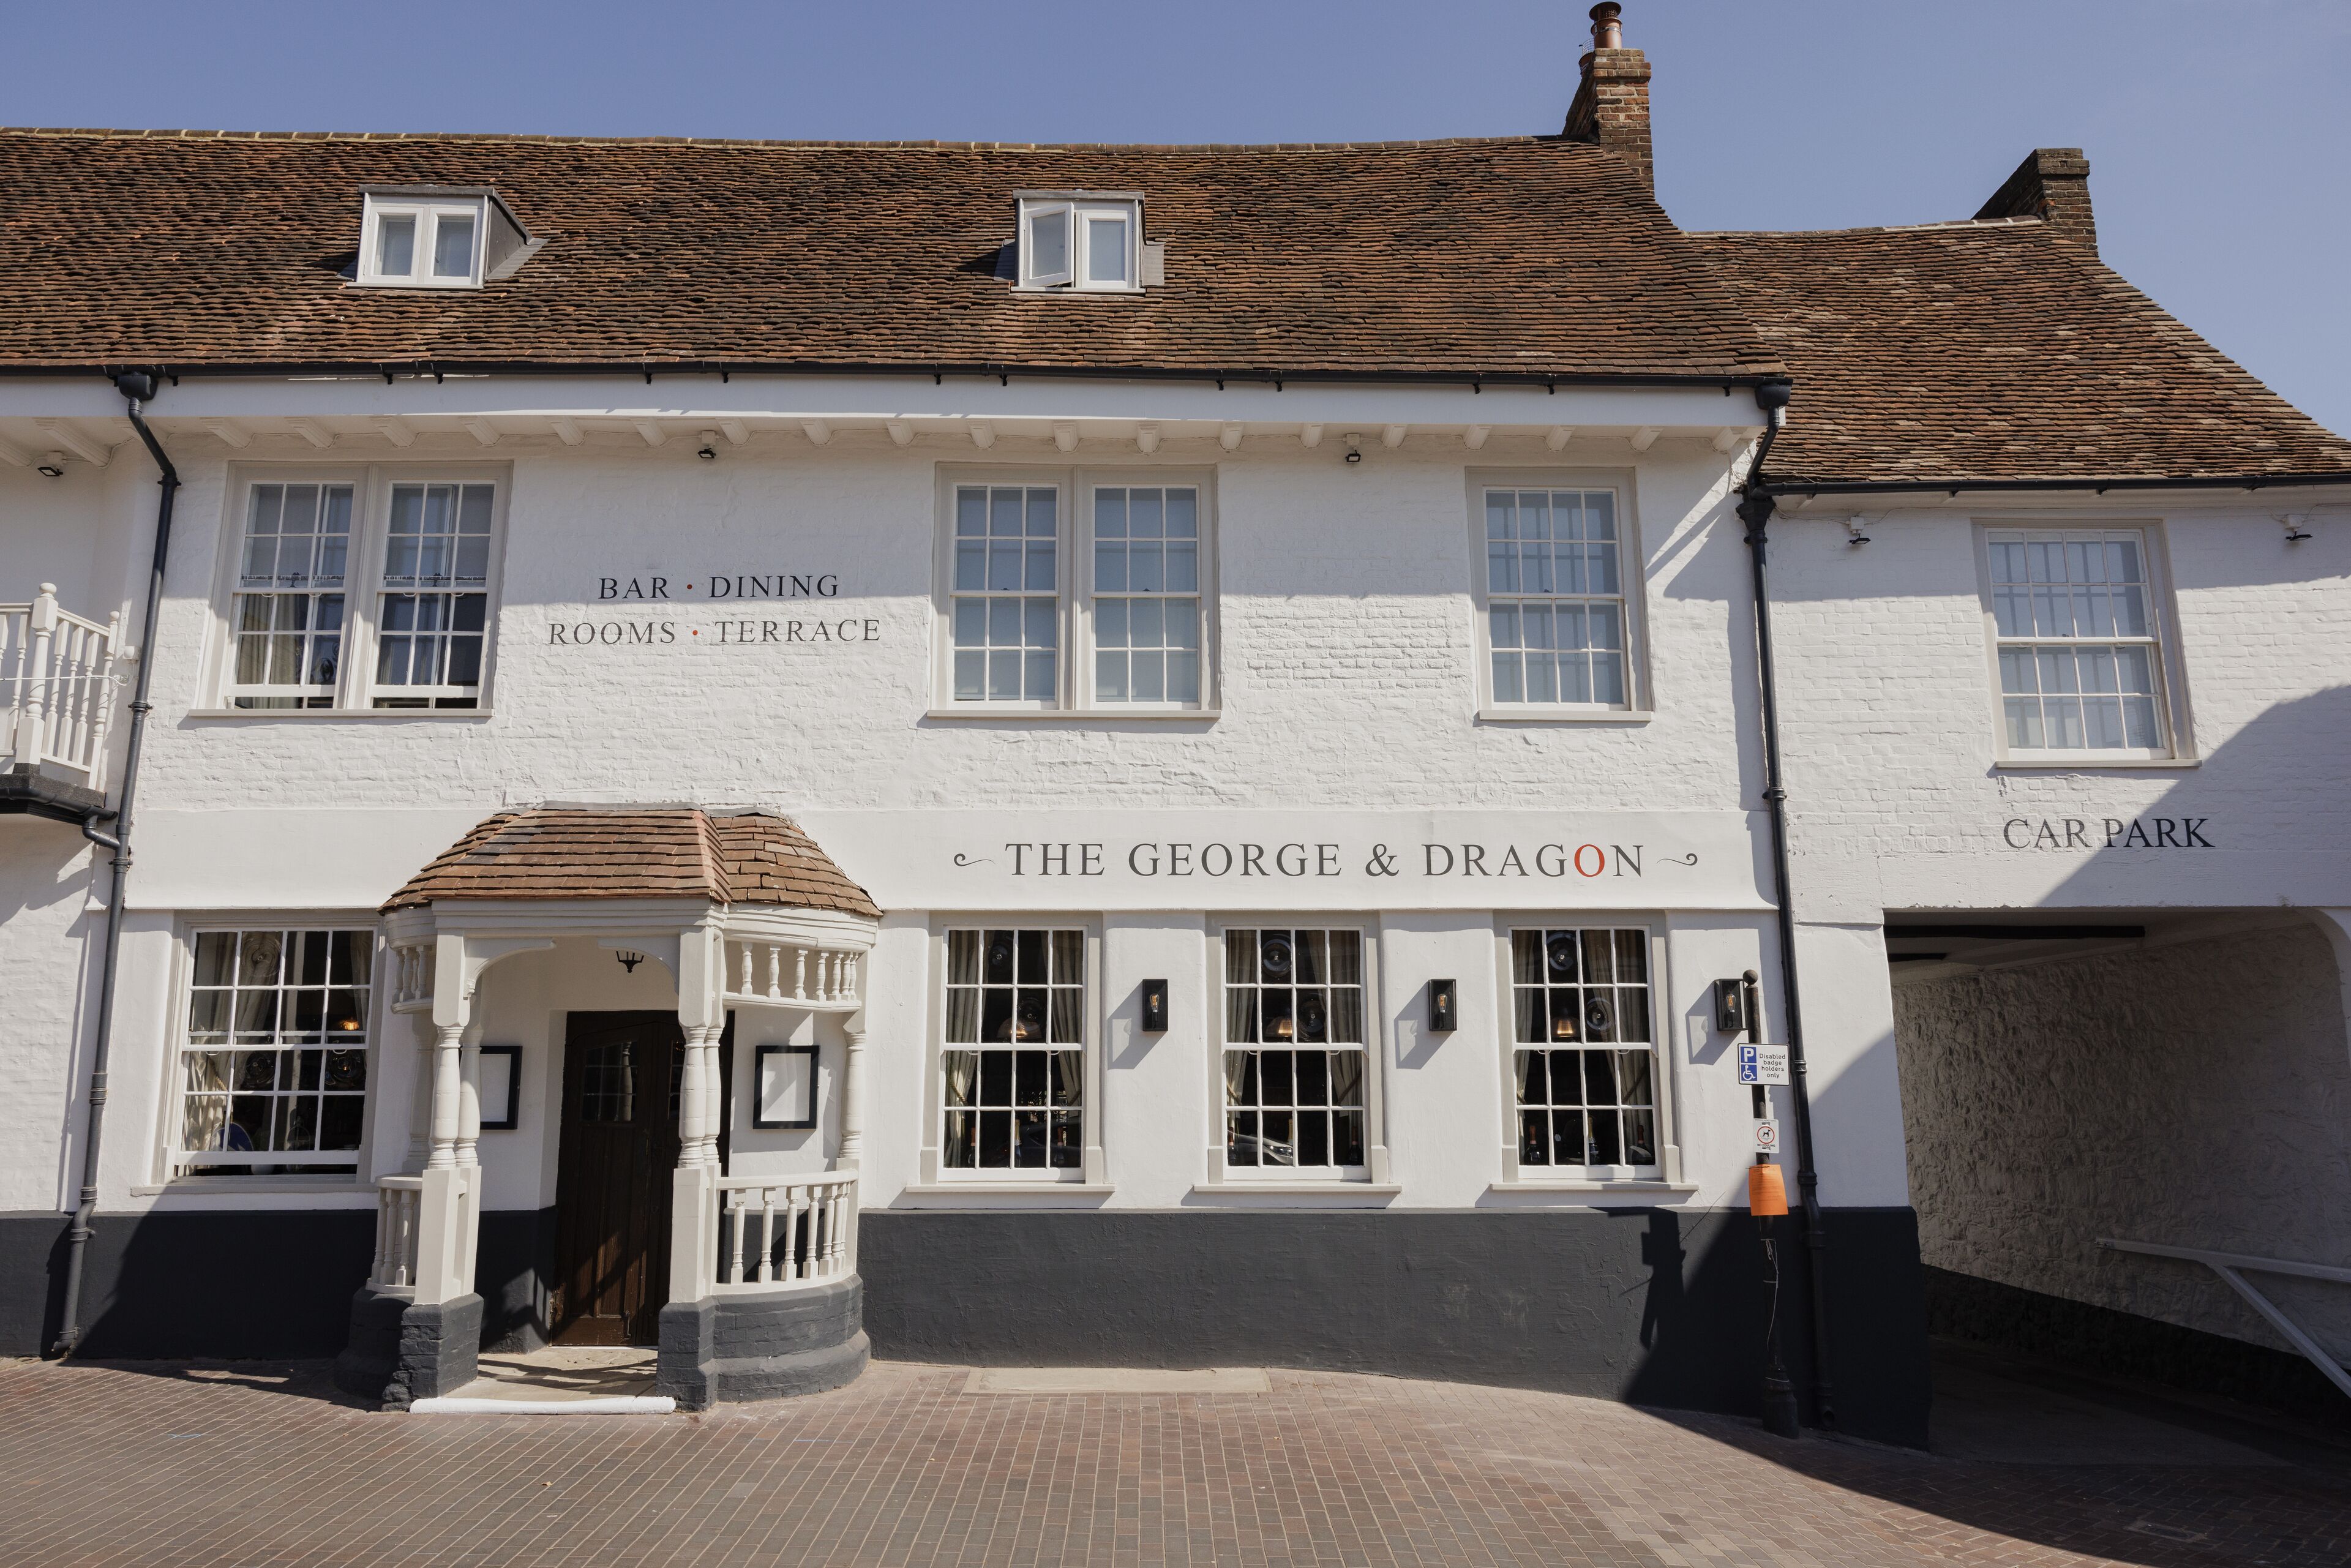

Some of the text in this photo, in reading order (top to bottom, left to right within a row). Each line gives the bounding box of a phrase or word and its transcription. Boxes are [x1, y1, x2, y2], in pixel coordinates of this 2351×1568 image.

[598, 574, 839, 599] BAR DINING
[549, 618, 880, 645] ROOMS TERRACE
[2003, 817, 2216, 849] CAR PARK
[1005, 842, 1644, 878] THE GEORGE & DRAGON
[1744, 1048, 1754, 1062] P
